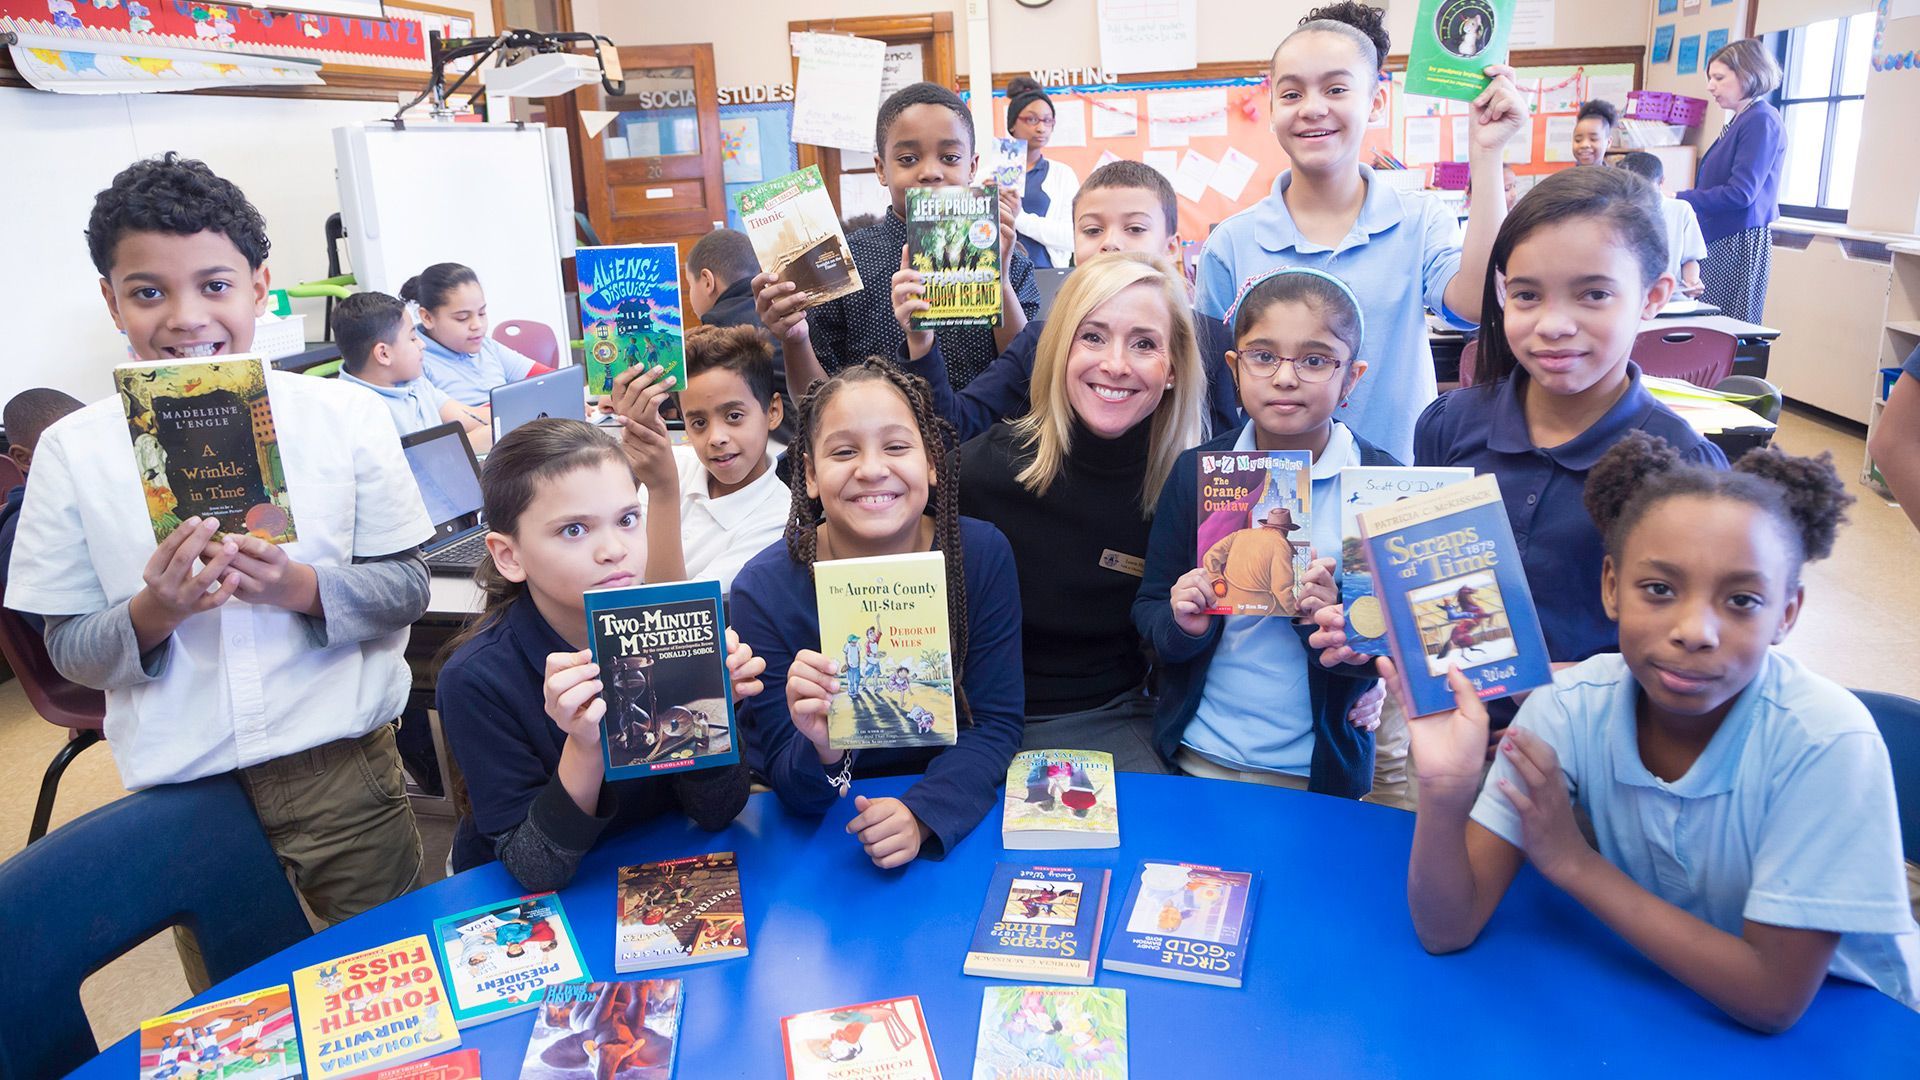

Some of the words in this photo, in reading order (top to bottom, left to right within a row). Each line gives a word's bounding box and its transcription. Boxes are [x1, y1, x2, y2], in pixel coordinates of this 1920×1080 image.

[404, 22, 417, 44] Z
[1031, 67, 1118, 88] WRITING
[717, 83, 795, 104] STUDIES
[648, 166, 662, 179] 20
[913, 198, 942, 217] JEFF
[944, 195, 992, 216] PROBST
[748, 210, 785, 230] Titanic
[959, 283, 996, 307] ISLAND
[162, 405, 238, 420] MADELEINE
[176, 418, 230, 430] L'ENGLE
[202, 445, 217, 457] A
[182, 463, 244, 478] Wrinkle
[1213, 477, 1229, 486] The
[1366, 479, 1393, 491] Scott
[190, 490, 203, 502] in
[206, 484, 246, 500] Time
[1203, 485, 1249, 500] Orange
[1204, 500, 1249, 513] Outlaw
[1375, 511, 1420, 530] PATRICIA
[1385, 527, 1479, 566] Scraps
[1467, 539, 1496, 555] 1879
[1400, 560, 1419, 579] of
[1416, 550, 1500, 581] Time
[829, 585, 844, 595] The
[846, 582, 890, 596] Aurora
[893, 581, 938, 599] County
[860, 599, 916, 613] All-Stars
[599, 609, 713, 637] TWO-MINUTE
[889, 626, 937, 637] DEBORAH
[619, 626, 714, 657] MYSTERIES
[675, 643, 701, 651] Encyclopedia
[889, 638, 922, 649] WILES
[659, 650, 687, 660] DONALD
[693, 647, 715, 656] SOBOL
[1481, 665, 1518, 683] West
[656, 760, 694, 769] SCHOLASTIC
[1019, 870, 1045, 880] West
[1048, 871, 1077, 882] Away
[691, 888, 736, 917] MASTERS
[466, 919, 497, 932] VOTE
[681, 914, 692, 923] of
[990, 930, 1016, 938] 1879
[993, 922, 1056, 940] Time
[1058, 932, 1074, 941] of
[621, 944, 693, 960] PAULSEN
[699, 937, 742, 951] GARY
[999, 931, 1078, 957] Scraps
[1165, 939, 1225, 957] GOLD
[1161, 950, 1231, 972] CIRCLE
[1224, 951, 1236, 959] of
[347, 946, 427, 981] FUSS
[1039, 959, 1081, 969] PATRICIA
[475, 963, 560, 993] PRESIDENT
[323, 966, 434, 1013] GRADE
[497, 977, 544, 997] CLASS
[547, 984, 588, 996] SMITH
[545, 991, 598, 1004] ROLAND
[318, 1015, 420, 1057] HURWITZ
[319, 1032, 423, 1073] JOHANNA
[827, 1058, 913, 1080] ROBINSON
